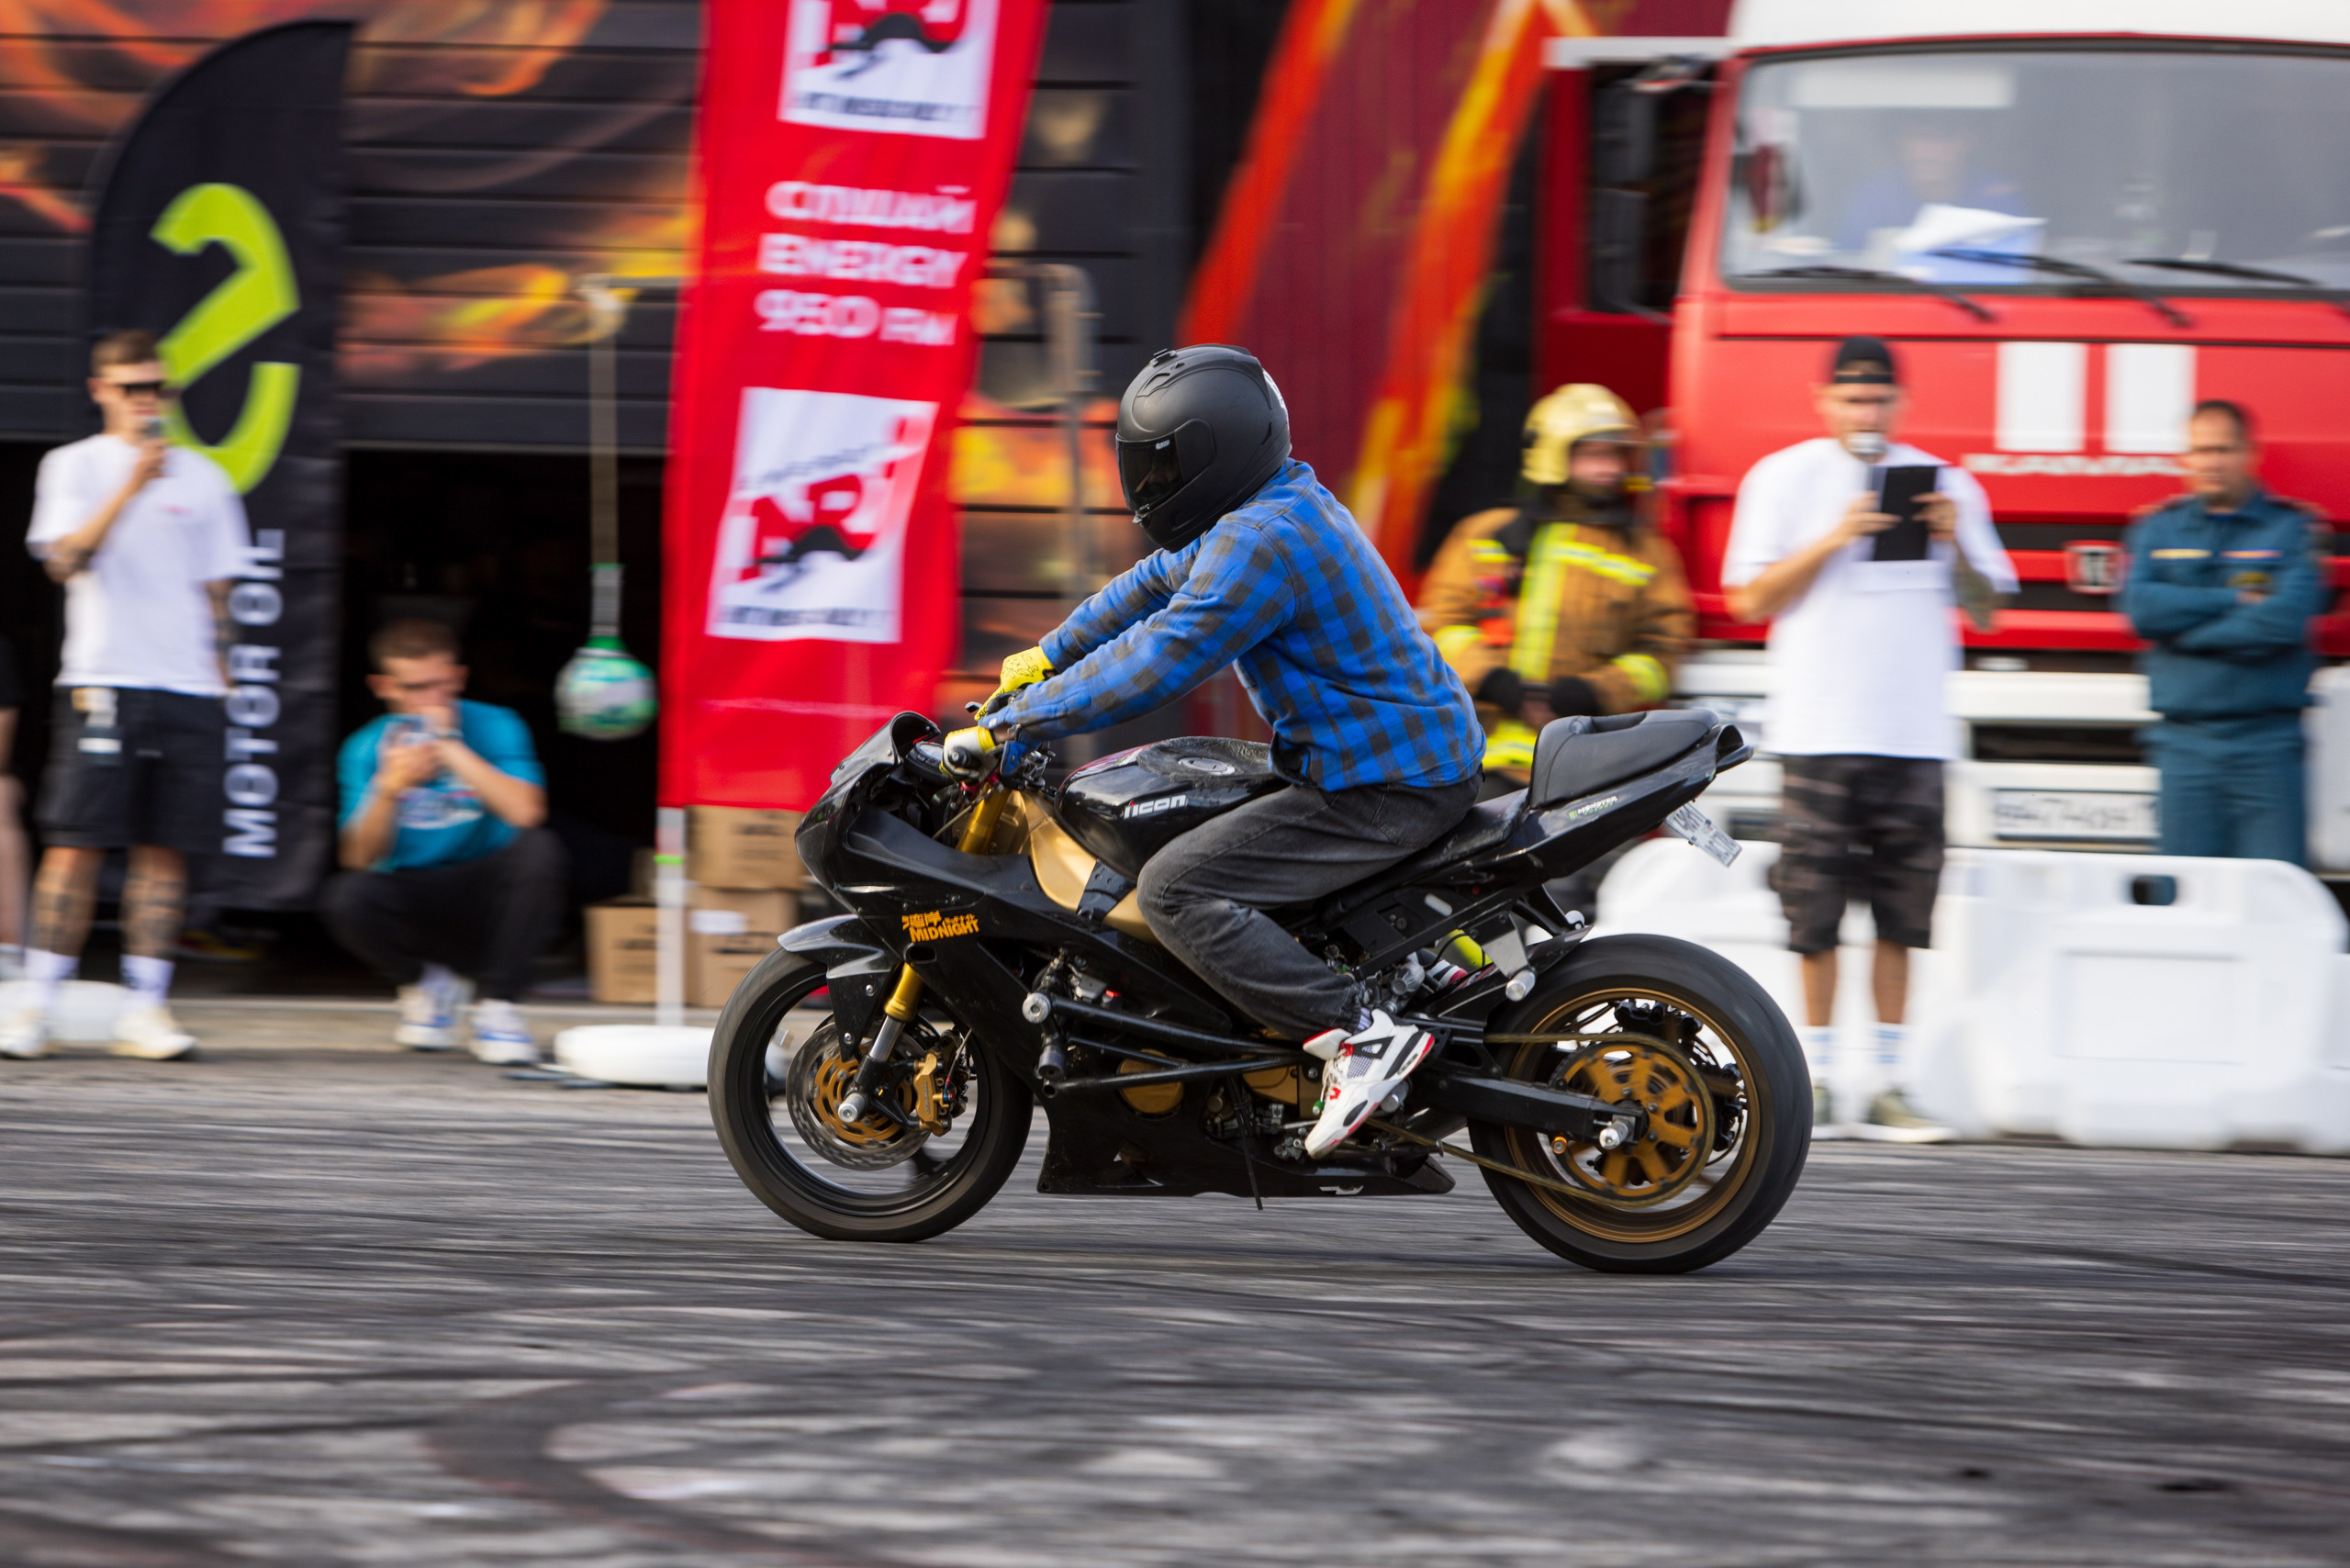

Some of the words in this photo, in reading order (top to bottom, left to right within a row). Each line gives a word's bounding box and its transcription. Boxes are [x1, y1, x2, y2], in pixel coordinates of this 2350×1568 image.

[757, 233, 968, 288] ENERGY
[222, 644, 281, 858] MOTOR
[909, 918, 979, 943] MIDNIGHT
